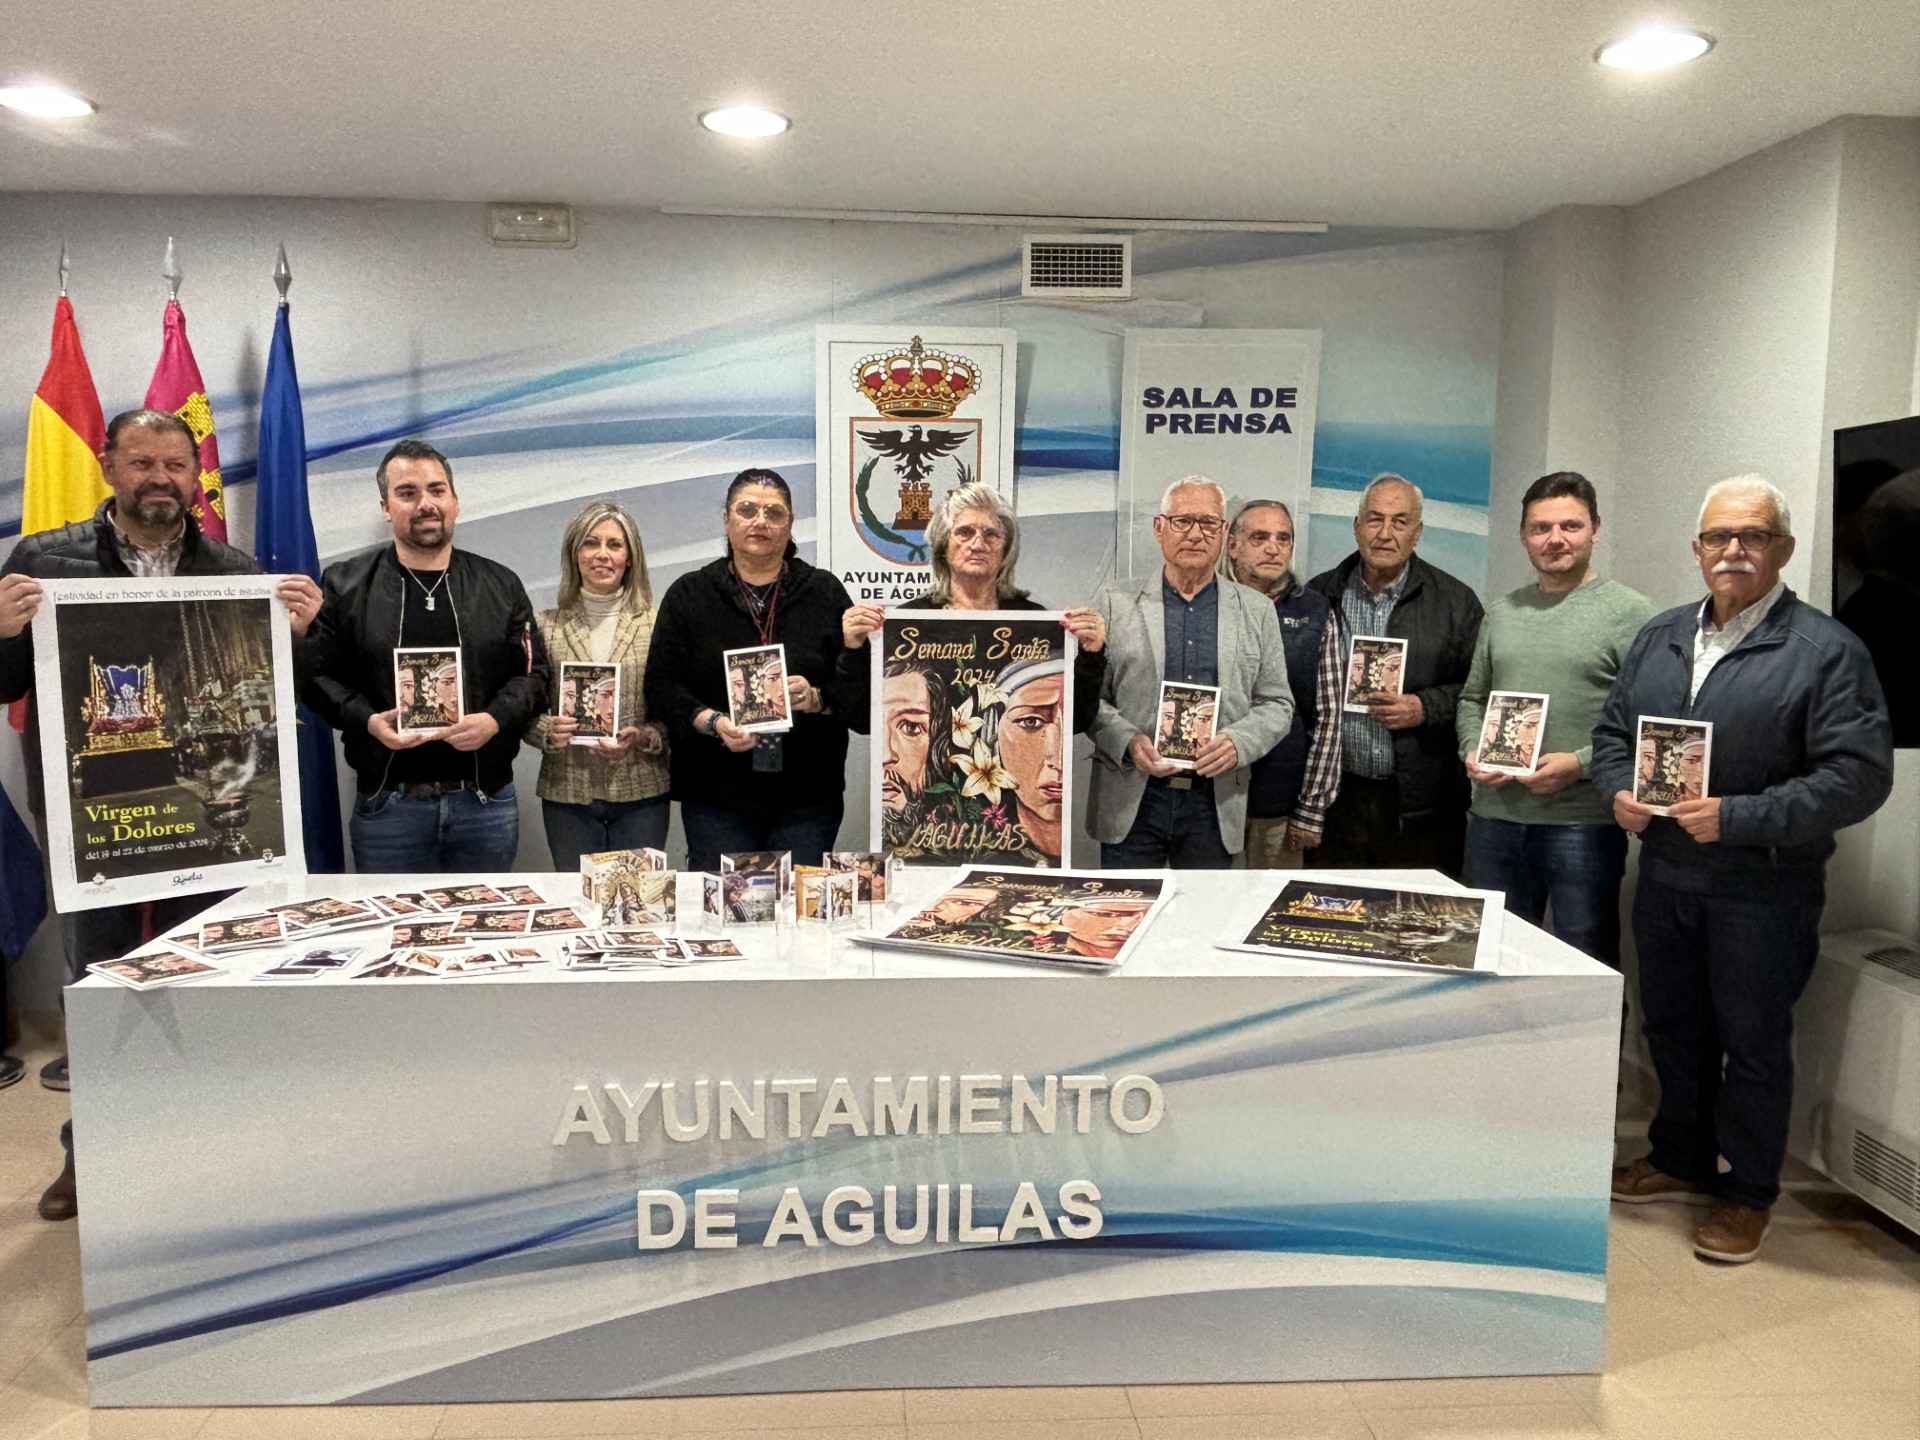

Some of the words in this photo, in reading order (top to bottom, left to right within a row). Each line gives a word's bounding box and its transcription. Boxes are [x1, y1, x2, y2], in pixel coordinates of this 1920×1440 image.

[1142, 387, 1237, 409] SALA
[1250, 387, 1298, 408] DE
[1145, 413, 1293, 435] PRENSA
[122, 589, 153, 599] honor
[861, 588, 884, 599] DE
[895, 627, 976, 660] Semana
[986, 627, 1051, 660] Santa
[950, 668, 995, 686] 2024
[84, 803, 156, 824] Virgen
[162, 803, 179, 814] de
[86, 833, 106, 845] los
[112, 821, 195, 842] Dolores
[553, 1074, 1165, 1146] AYUNTAMIENTO
[637, 1188, 741, 1250] DE
[762, 1179, 1104, 1248] AGUILAS
